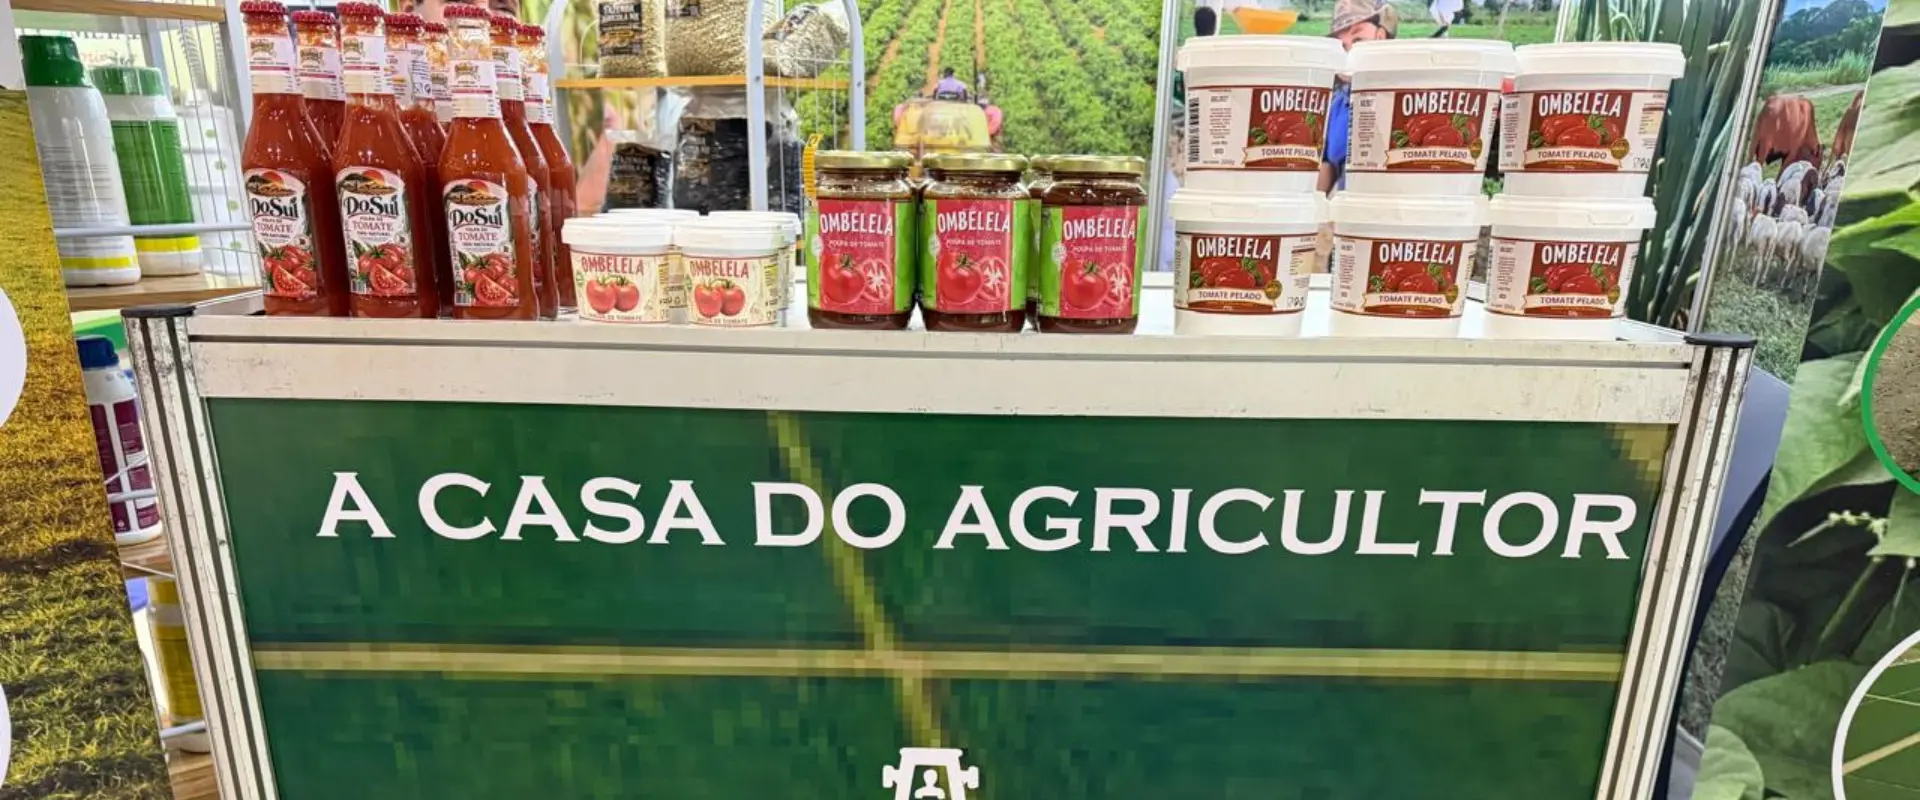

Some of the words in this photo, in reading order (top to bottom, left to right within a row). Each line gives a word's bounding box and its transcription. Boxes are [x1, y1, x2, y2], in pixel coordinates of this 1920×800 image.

[1260, 89, 1326, 115] OMBELELA
[1402, 91, 1481, 117] OMBELELA
[1538, 92, 1622, 117] OMBELELA
[1261, 148, 1292, 156] TOMATE
[1293, 149, 1316, 158] PELADO
[1402, 151, 1437, 159] TOMATE
[1439, 151, 1467, 159] PELADO
[1538, 151, 1570, 159] TOMATE
[1573, 151, 1607, 160] PELADO
[256, 222, 293, 233] TOMATE
[352, 221, 394, 231] TOMATE
[819, 212, 893, 236] OMBELELA
[937, 211, 1011, 234] OMBELELA
[1063, 218, 1136, 241] OMBELELA
[458, 232, 498, 241] TOMATE
[1196, 237, 1272, 260] OMBELELA
[1379, 242, 1455, 265] OMBELELA
[1541, 243, 1619, 266] OMBELELA
[581, 256, 645, 276] OMBELELA
[689, 260, 750, 278] OMBELELA
[1198, 291, 1228, 299] TOMATE
[1230, 292, 1262, 300] PELADO
[1379, 295, 1412, 303] TOMATE
[1414, 296, 1442, 304] PELADO
[1576, 297, 1605, 305] PELADO
[316, 471, 397, 539] A
[417, 472, 727, 546] CASA
[751, 481, 907, 549] DO
[933, 484, 1639, 560] AGRICULTOR
